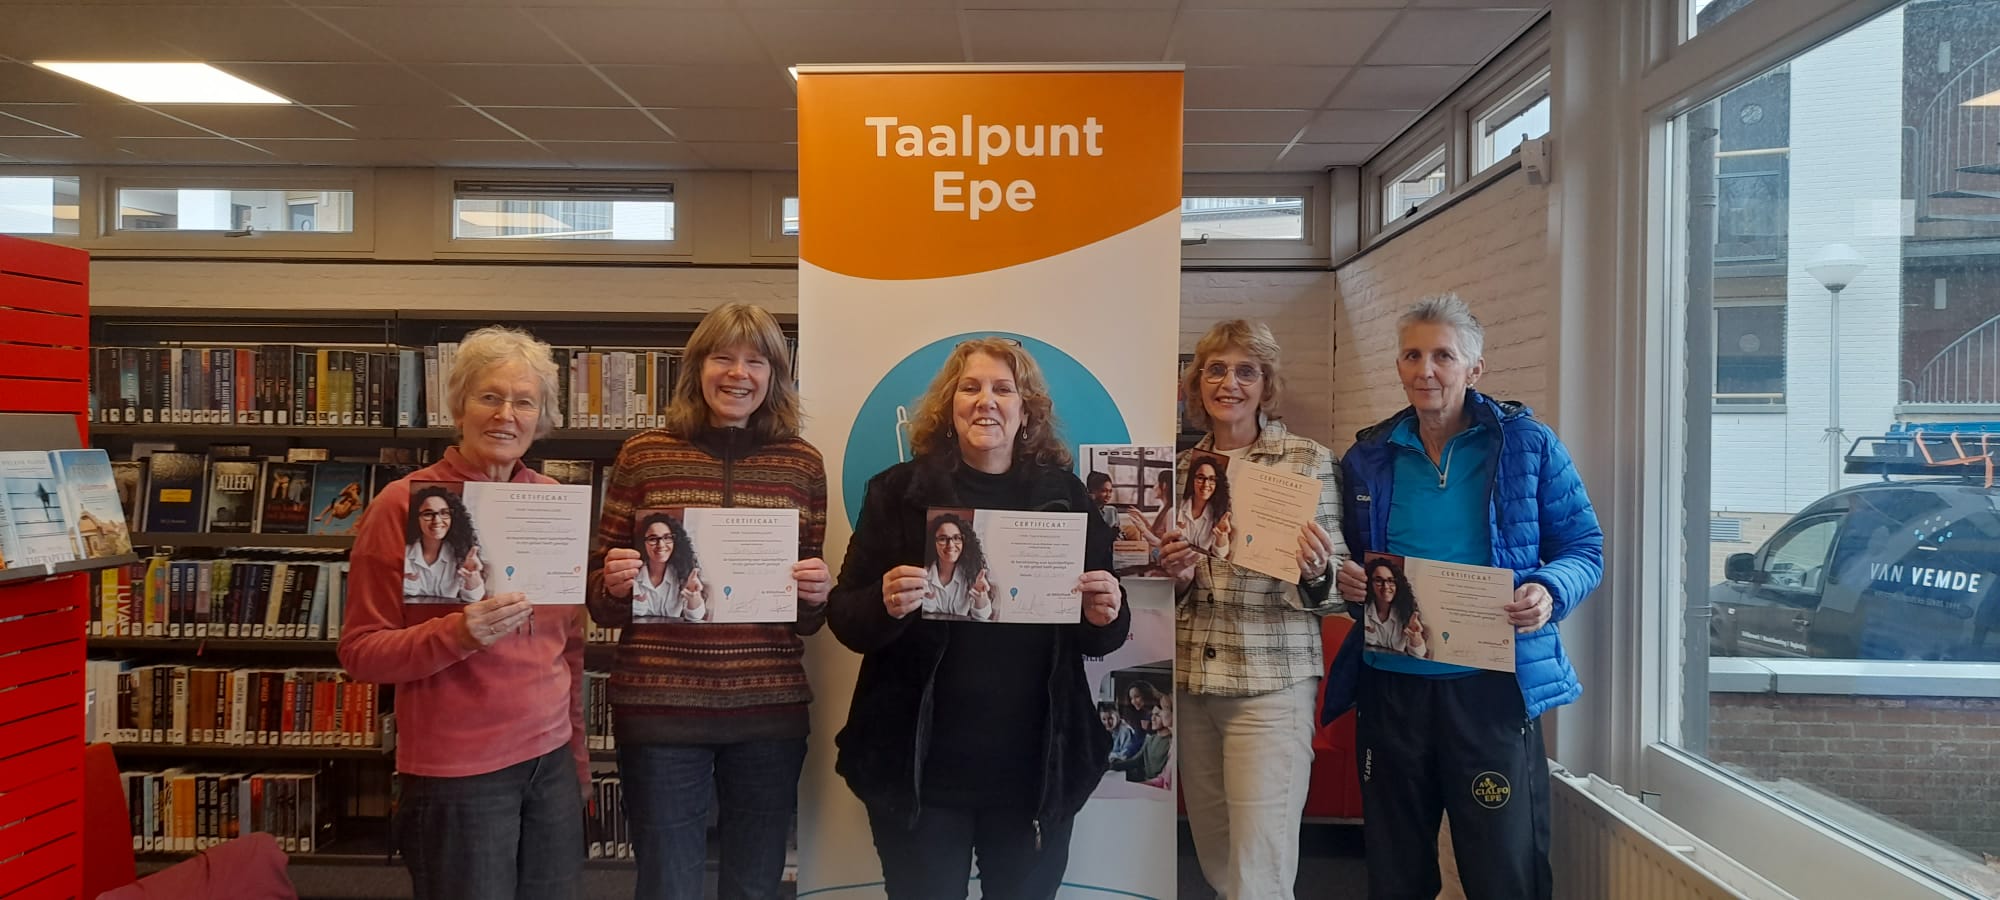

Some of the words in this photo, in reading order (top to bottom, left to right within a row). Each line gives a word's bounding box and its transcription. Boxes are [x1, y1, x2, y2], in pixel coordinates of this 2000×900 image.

[864, 114, 1104, 165] Taalpunt
[934, 170, 1036, 220] Epe
[216, 474, 254, 491] ALLEEN
[1259, 474, 1303, 490] CERTIFICAAT
[510, 493, 568, 502] CERTIFICAAT
[1014, 521, 1067, 529] CERTIFICAAT
[1441, 570, 1492, 582] CERTIFICAAT
[1870, 562, 1904, 583] VAN
[1911, 566, 1982, 593] VEMDE
